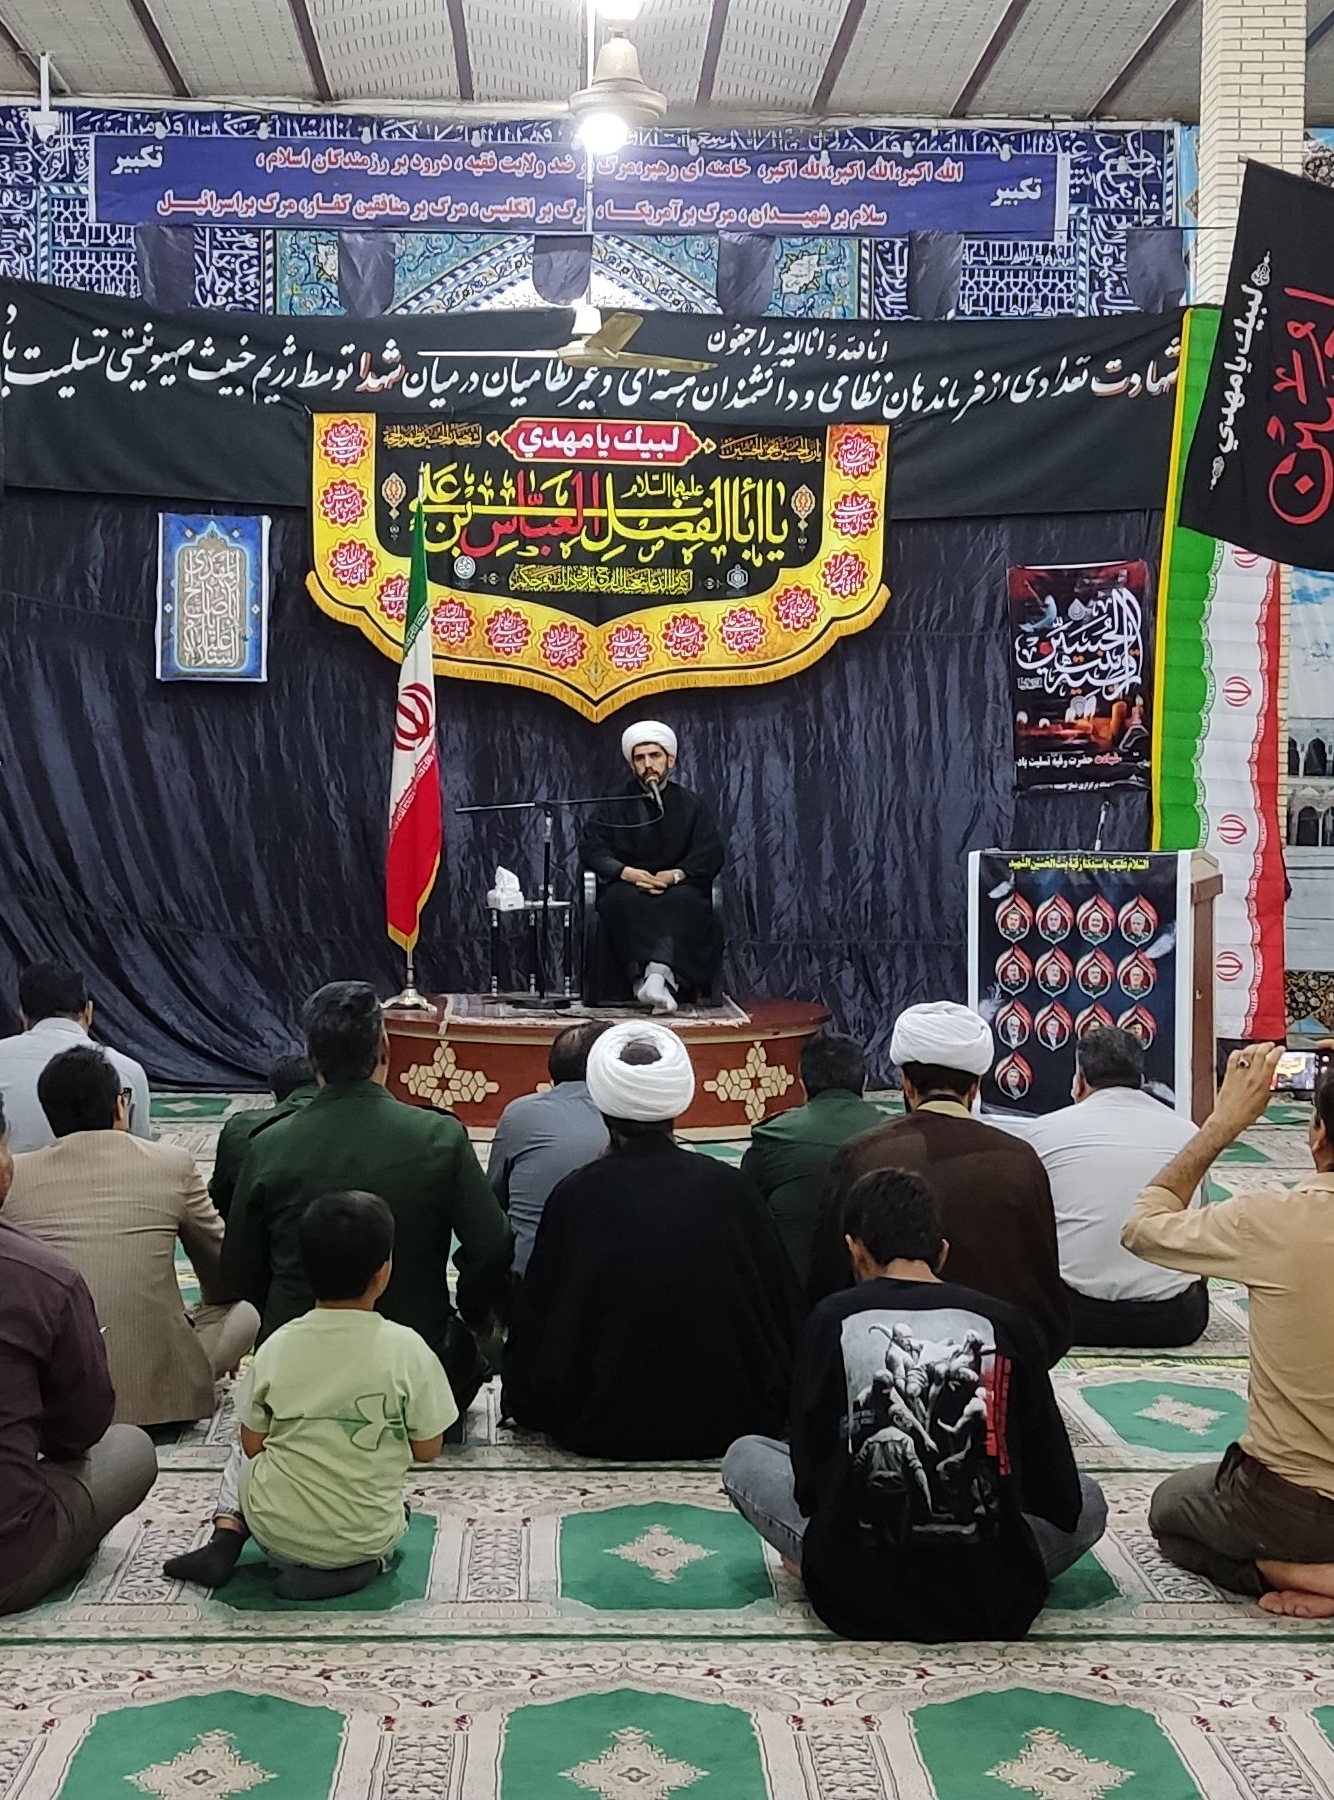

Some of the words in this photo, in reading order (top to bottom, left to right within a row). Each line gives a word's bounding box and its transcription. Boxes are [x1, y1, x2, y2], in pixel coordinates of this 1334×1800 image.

[110, 144, 164, 175] تکبیر
[311, 149, 390, 178] رزمندگان
[391, 154, 409, 176] بر
[410, 154, 452, 177] درود
[499, 152, 546, 180] ولایت
[548, 154, 576, 175] ضد
[680, 157, 705, 181] ای
[706, 157, 752, 177] خامنه
[935, 157, 963, 182] الله
[990, 177, 1043, 206] تکبیر
[352, 193, 409, 222] منافقین
[410, 201, 428, 222] بر
[536, 204, 554, 224] بر
[831, 208, 849, 230] بر
[850, 203, 887, 230] سلام
[3, 328, 109, 399] تسلیت
[187, 334, 258, 397] خبیث
[252, 334, 298, 405] رژیم
[297, 342, 356, 391] توسط
[354, 338, 407, 393] شهدا
[401, 356, 460, 410] میان
[818, 369, 884, 414] نظامی
[1010, 355, 1091, 405] تعدادی
